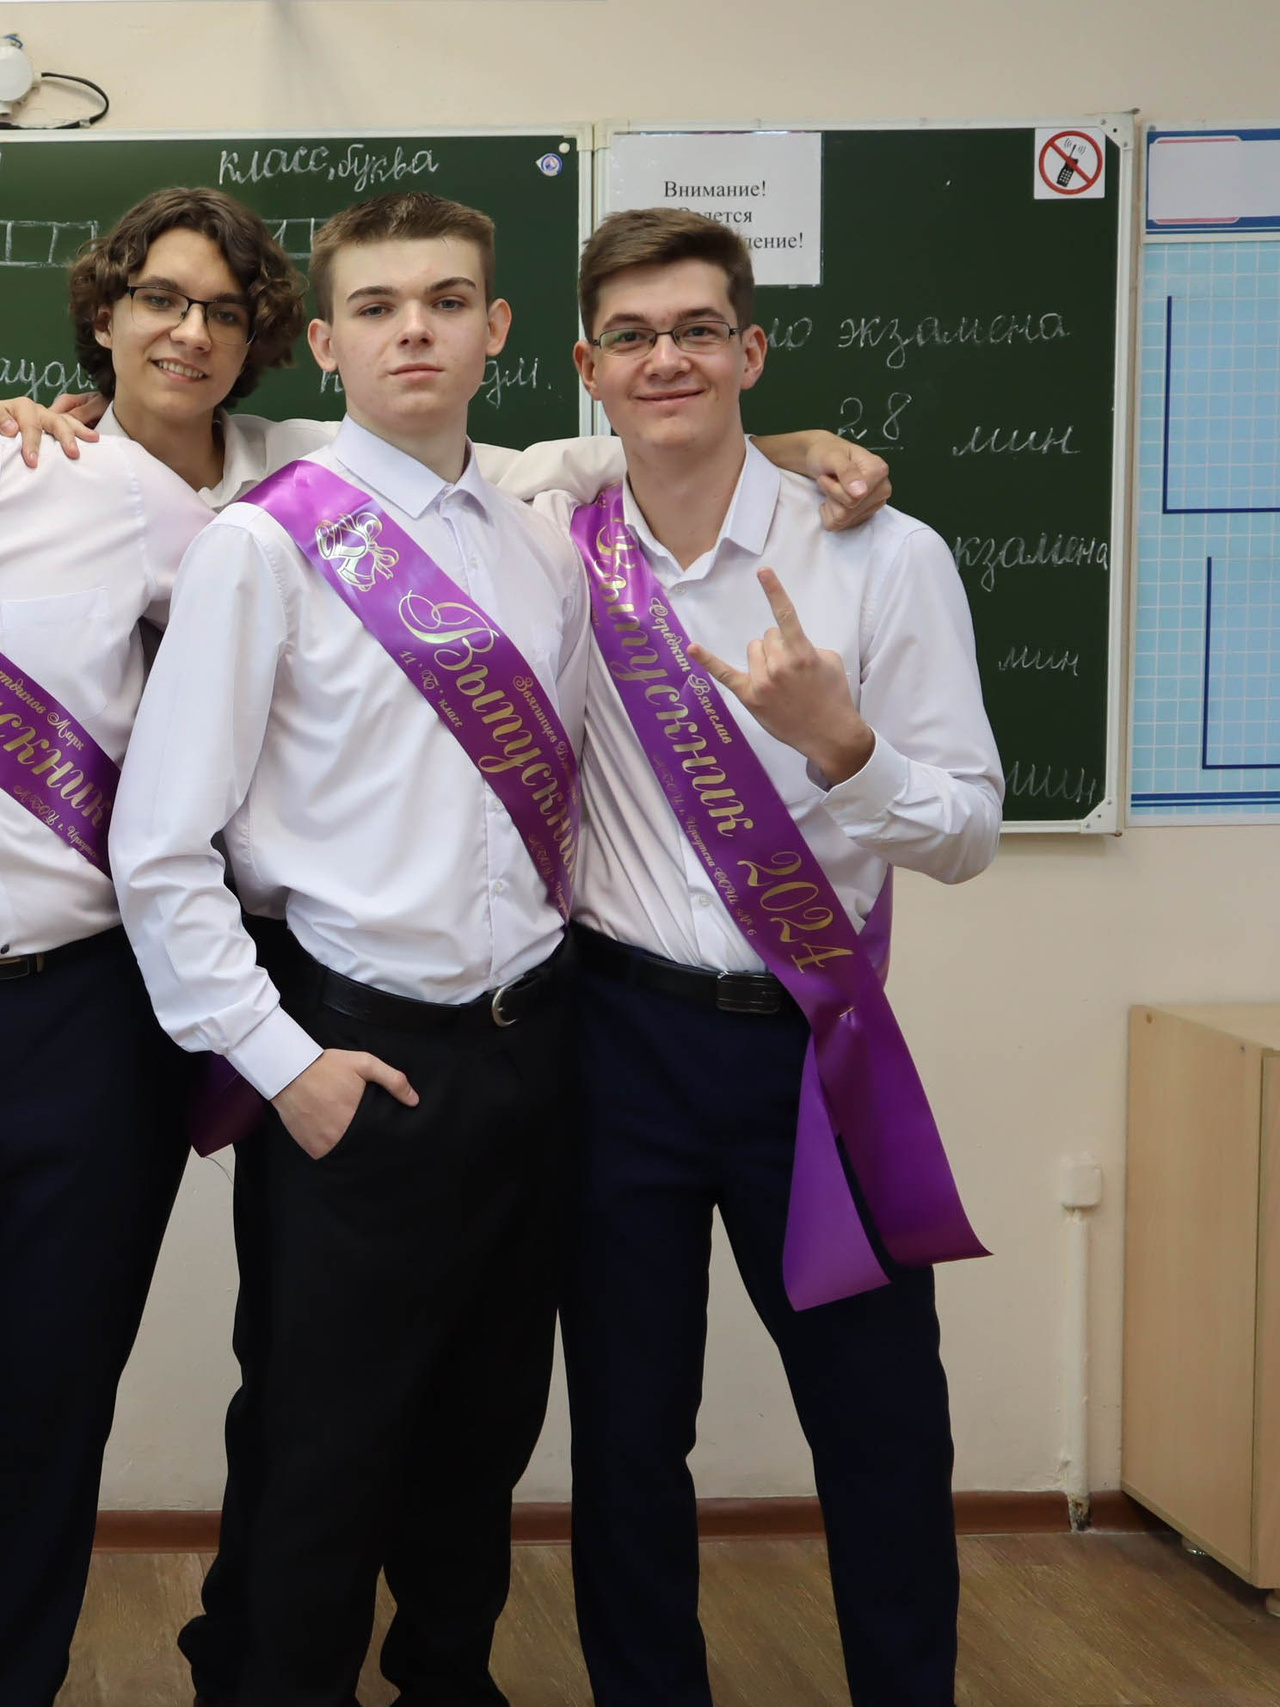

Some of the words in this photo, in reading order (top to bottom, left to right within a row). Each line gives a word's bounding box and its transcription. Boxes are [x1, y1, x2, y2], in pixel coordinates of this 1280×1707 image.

[664, 180, 766, 198] Внимание!
[952, 424, 1081, 456] мин
[952, 532, 1109, 593] кзамена
[997, 645, 1080, 677] мин
[687, 672, 733, 745] Вячеслав
[46, 711, 85, 751] Марк
[736, 850, 854, 974] 2024
